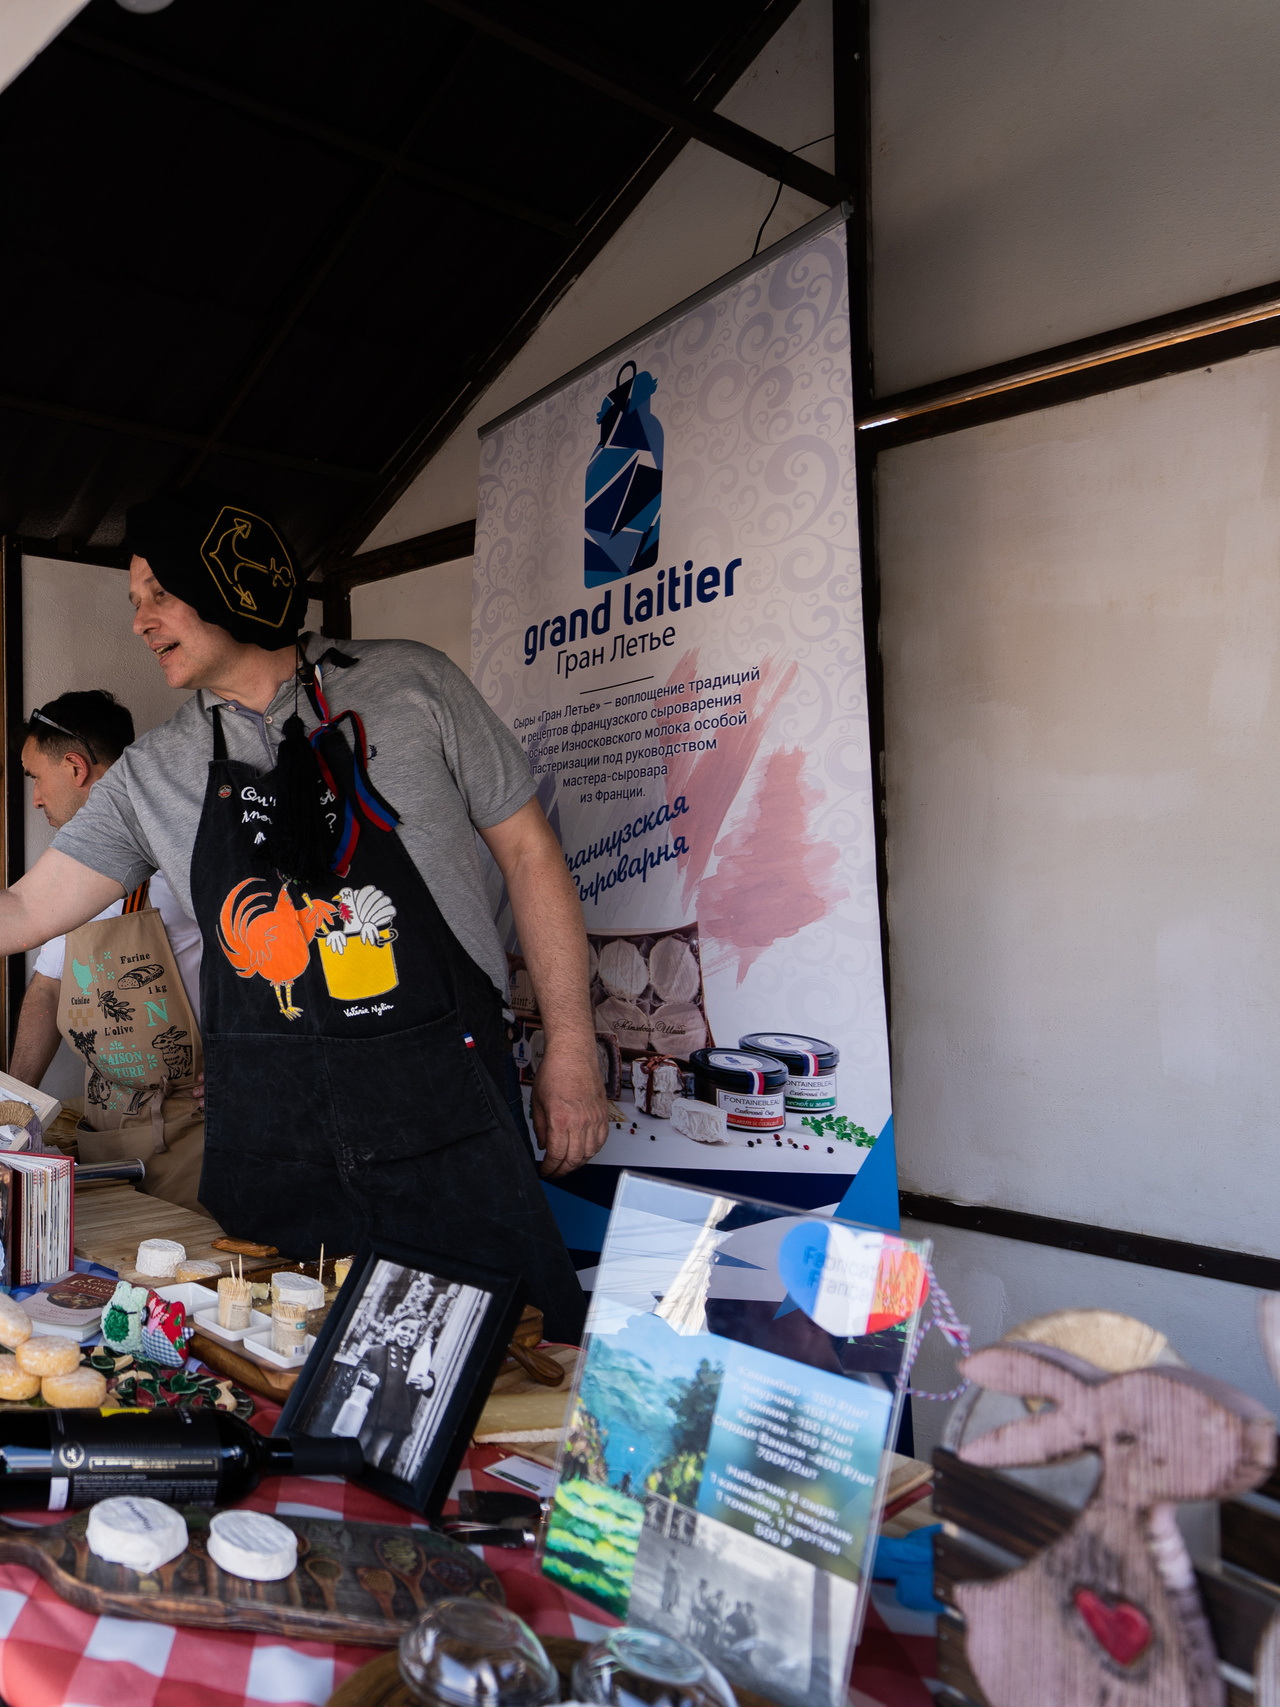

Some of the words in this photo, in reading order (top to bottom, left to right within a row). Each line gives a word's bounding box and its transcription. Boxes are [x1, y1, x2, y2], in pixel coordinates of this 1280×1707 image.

[524, 590, 612, 666] grand
[623, 558, 742, 626] laitier
[557, 646, 604, 679] Гран
[610, 626, 676, 662] Летье
[513, 716, 536, 730] Сыры
[537, 709, 562, 725] «Гран
[564, 701, 601, 717] Летье»
[615, 683, 685, 707] воплощение
[688, 666, 760, 694] традиций
[521, 736, 526, 744] и
[527, 726, 568, 745] рецептов
[571, 710, 648, 736] французского
[650, 694, 742, 719] сыроварения
[529, 744, 559, 759] основе
[561, 730, 642, 753] Износковского
[644, 722, 690, 739] молока
[694, 710, 747, 731] особой
[532, 756, 600, 775] пастеризации
[603, 753, 623, 765] под
[625, 738, 717, 763] руководством
[563, 764, 668, 788] мастера-сыровара
[580, 793, 592, 803] из
[595, 786, 646, 804] Франции.
[120, 953, 151, 965] Farine
[148, 986, 153, 994] 1
[155, 985, 168, 994] kg
[143, 998, 169, 1027] N
[104, 1026, 134, 1036] L'olive
